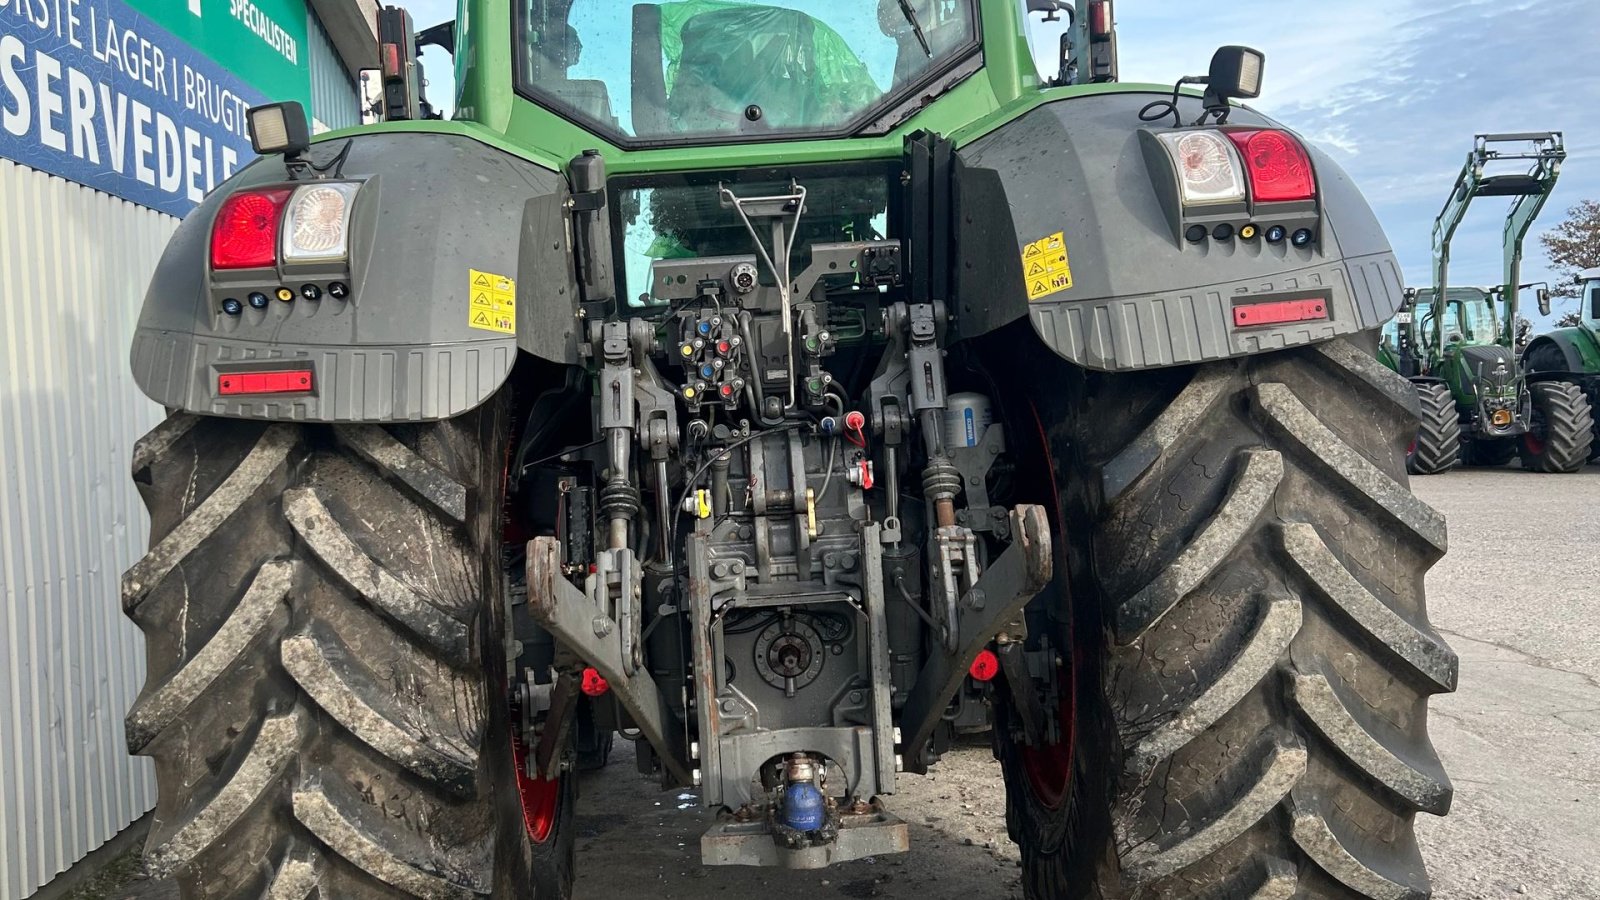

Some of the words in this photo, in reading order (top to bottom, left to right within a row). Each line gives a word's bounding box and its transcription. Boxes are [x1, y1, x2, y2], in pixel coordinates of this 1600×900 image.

[230, 0, 297, 66] SPECIALISTEN
[0, 0, 82, 49] STE
[91, 6, 167, 96] LAGER
[172, 57, 178, 101] I
[184, 64, 251, 142] BRUGTE
[966, 417, 974, 440] WABCO
